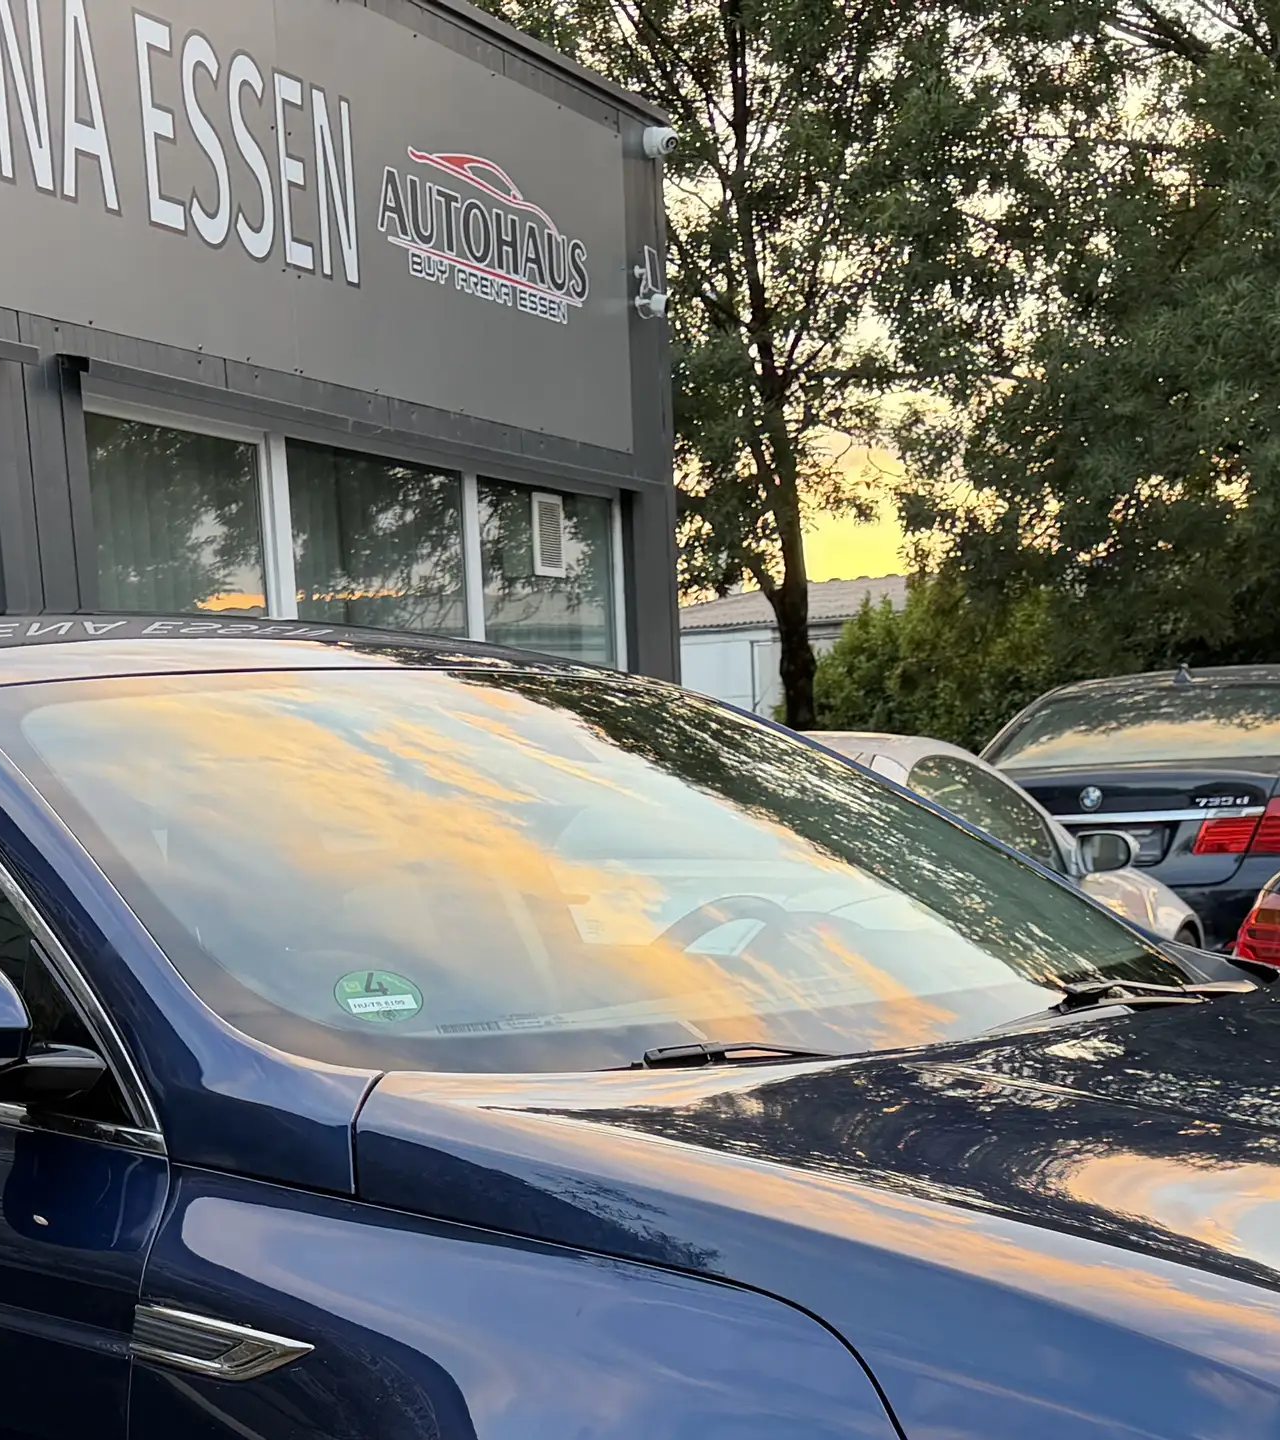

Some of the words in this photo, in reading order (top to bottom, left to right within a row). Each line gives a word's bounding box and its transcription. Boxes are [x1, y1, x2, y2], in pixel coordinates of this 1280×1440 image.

[132, 8, 360, 288] ESSEN
[378, 165, 589, 302] AUTOHAUS
[409, 249, 450, 284] BUY
[455, 266, 513, 306] ARENA
[517, 288, 568, 325] ESSEN
[364, 972, 390, 995] 4
